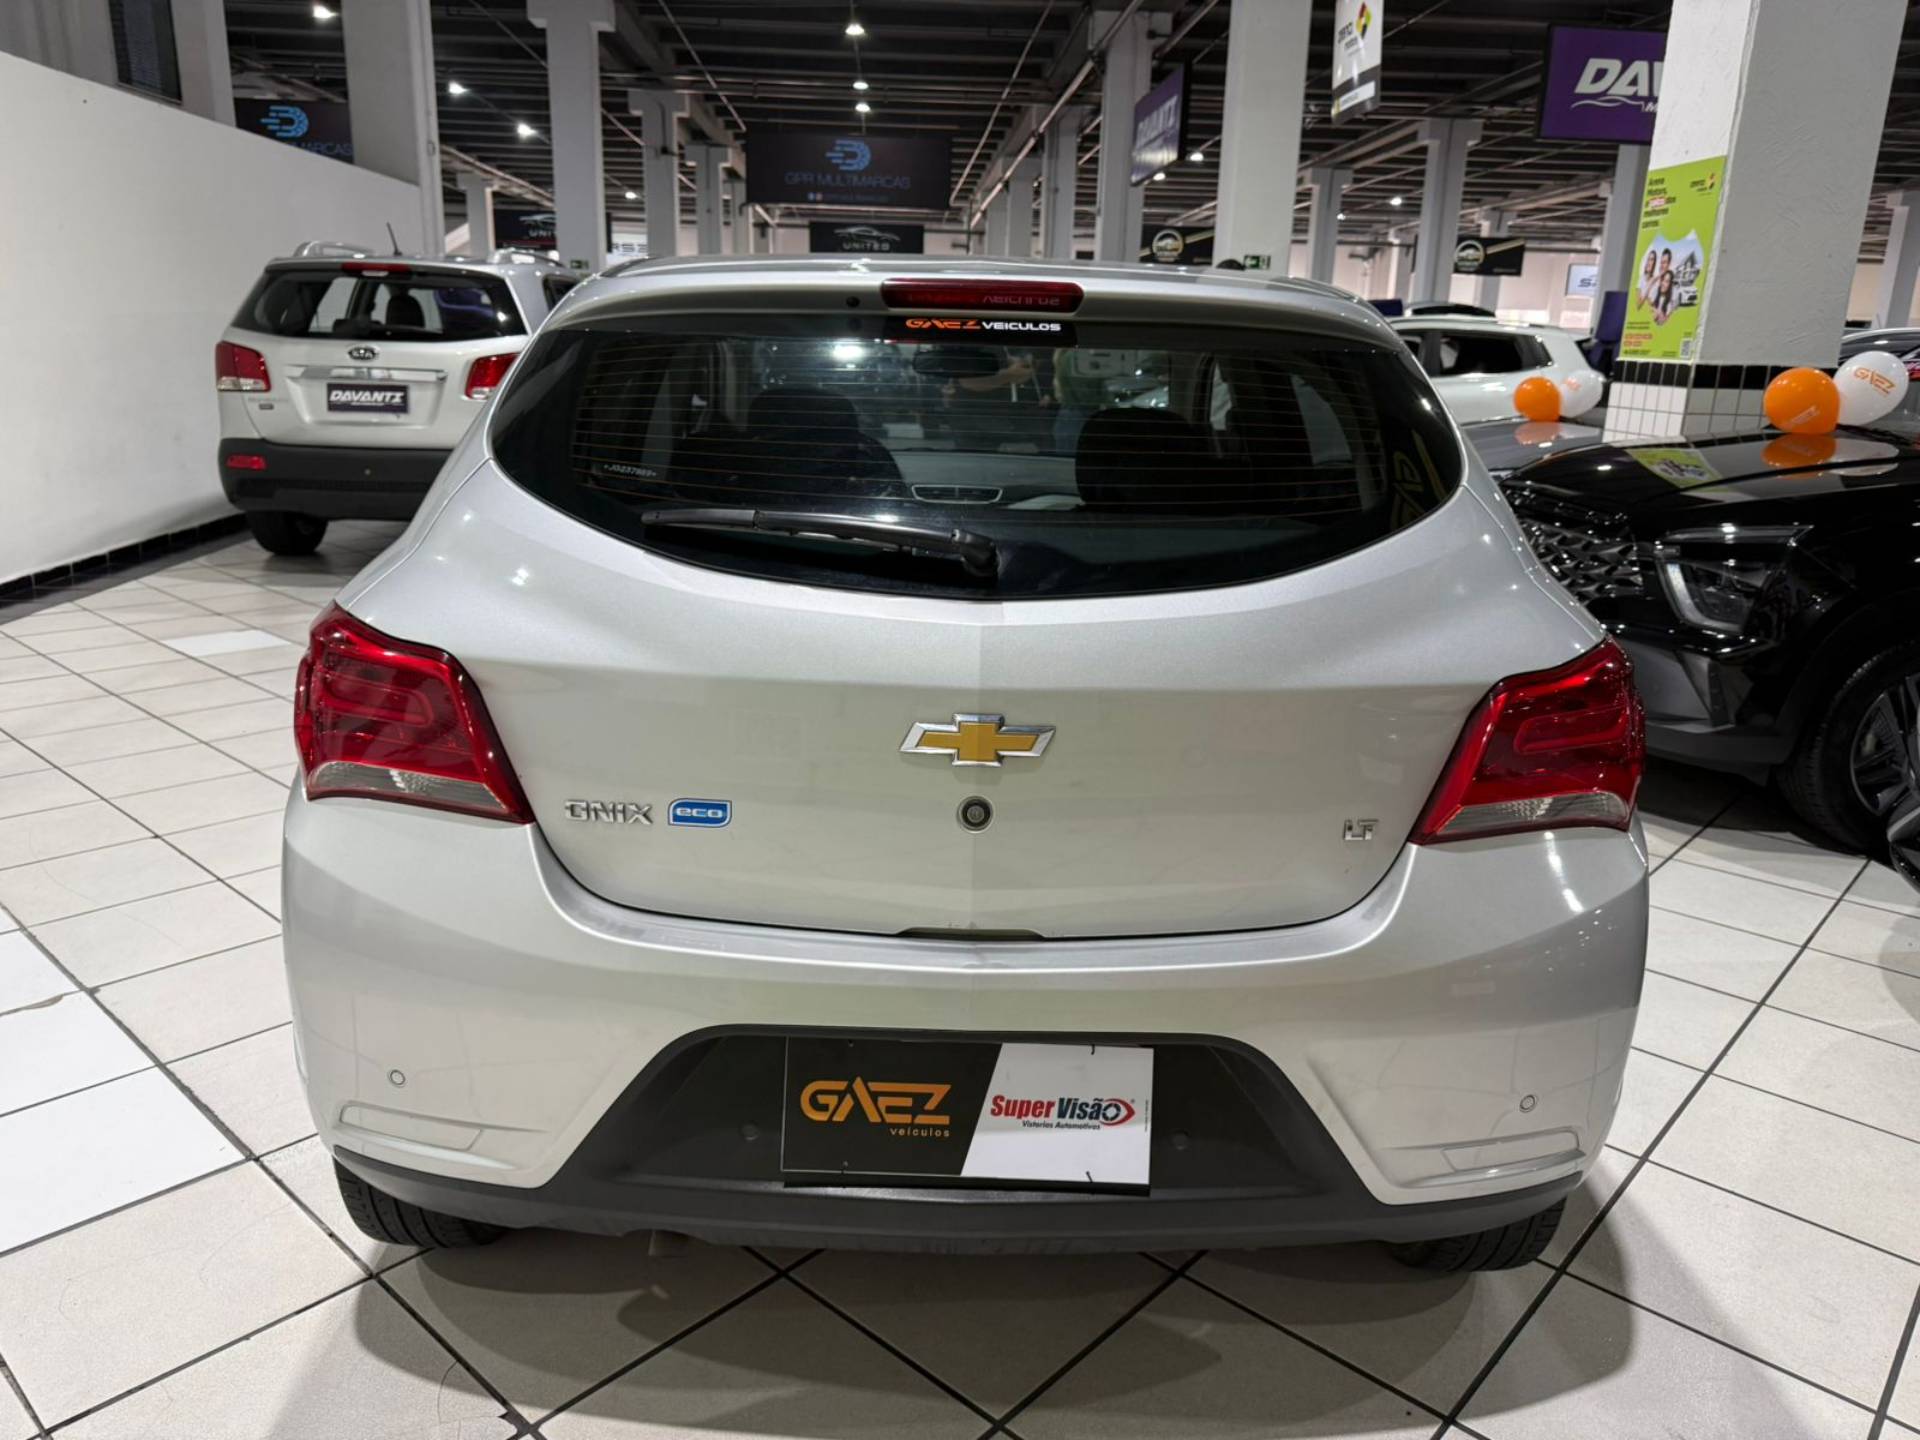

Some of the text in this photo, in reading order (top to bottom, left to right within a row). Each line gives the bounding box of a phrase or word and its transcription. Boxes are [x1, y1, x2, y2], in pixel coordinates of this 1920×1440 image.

[982, 320, 1061, 332] VEICULOS
[329, 389, 404, 404] DAVANTZ
[675, 806, 724, 819] eco
[1343, 818, 1378, 841] LT
[800, 1076, 951, 1125] GAEZ
[990, 1095, 1056, 1120] Super
[1057, 1097, 1122, 1122] Visão
